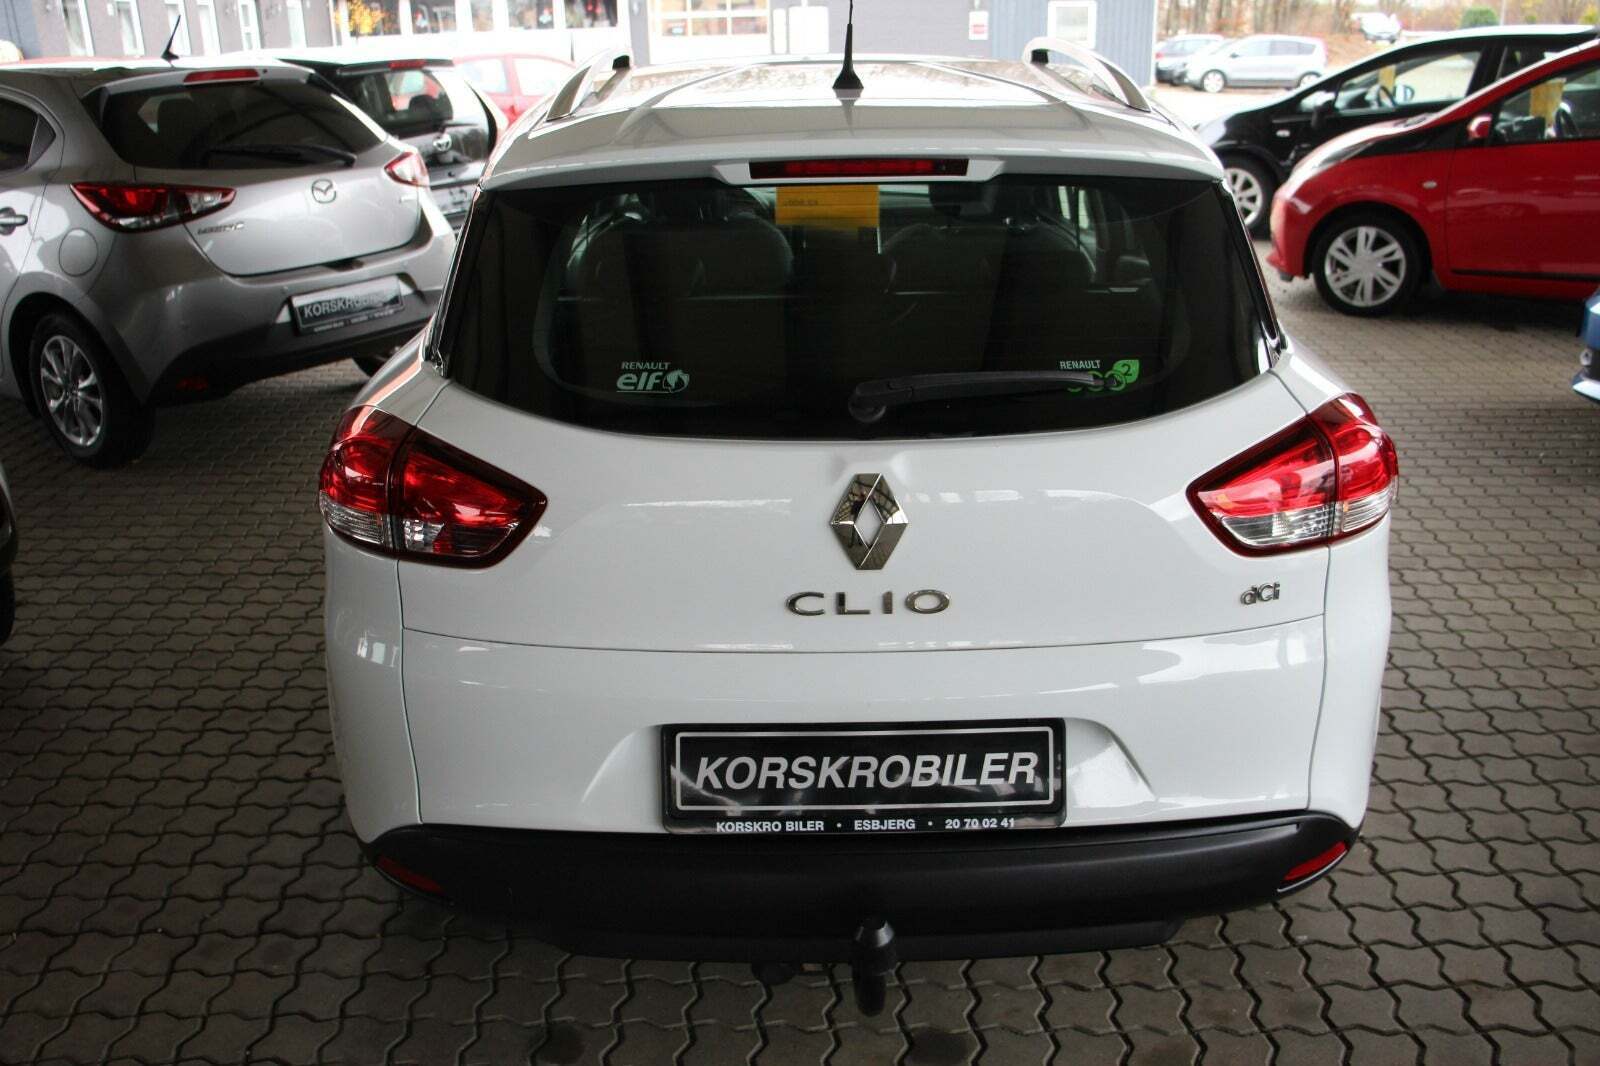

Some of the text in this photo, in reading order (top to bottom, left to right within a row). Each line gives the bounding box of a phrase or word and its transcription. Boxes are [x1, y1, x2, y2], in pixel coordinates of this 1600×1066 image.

[621, 361, 671, 370] RENAULT
[1060, 360, 1100, 369] RENAULT
[616, 372, 663, 390] elf
[786, 590, 949, 615] CLIO
[1240, 582, 1280, 605] dCi
[696, 752, 1038, 789] KORSKROBILER
[716, 817, 1015, 832] KORSKRO BILER ESBJERG 20 70 02 41
